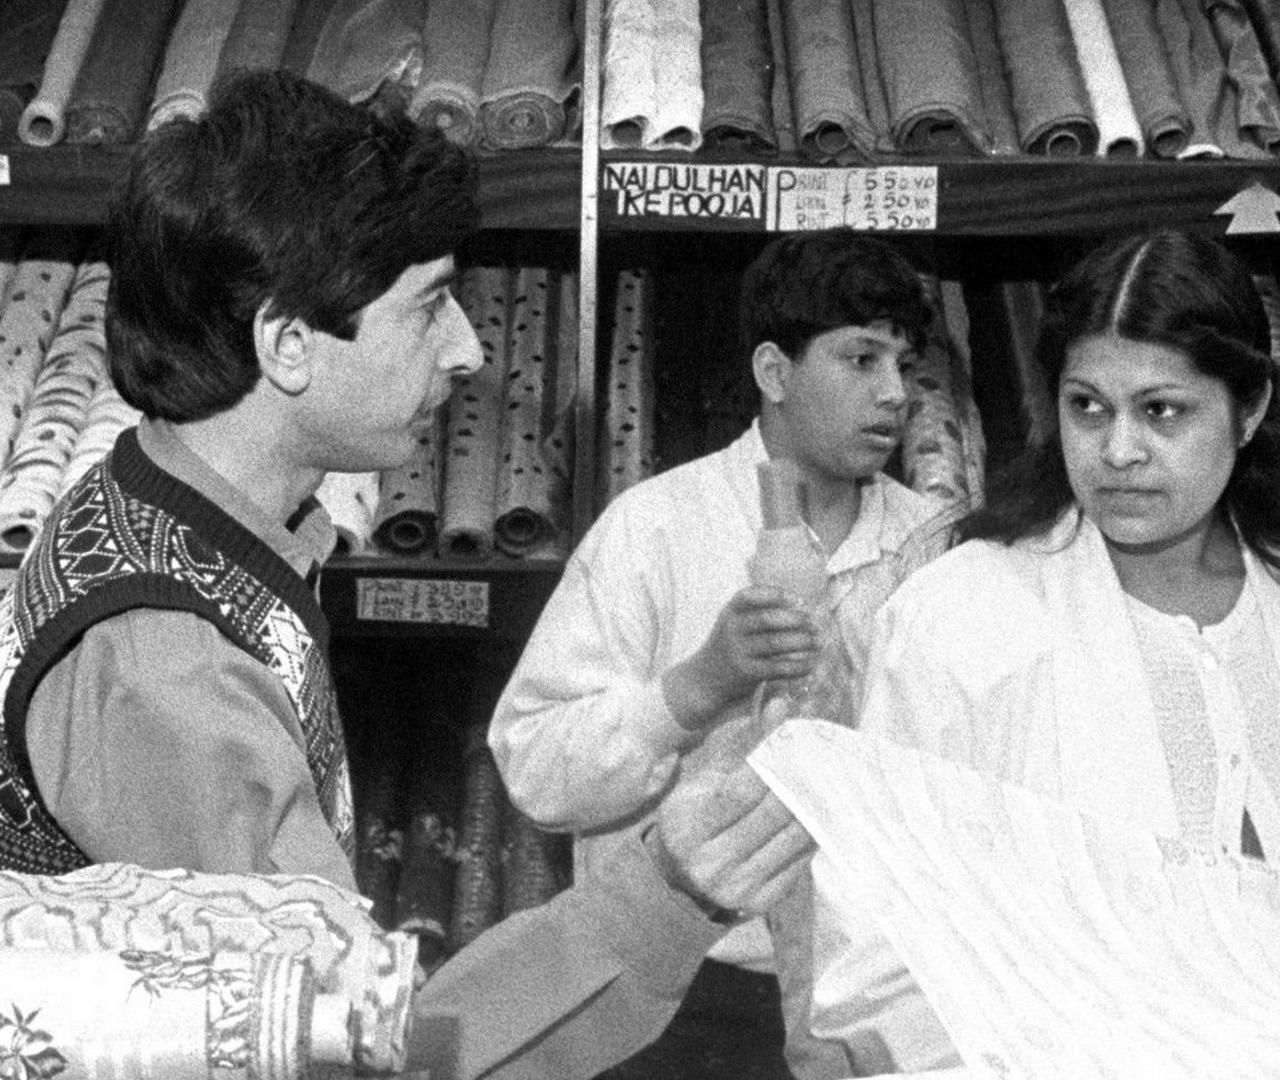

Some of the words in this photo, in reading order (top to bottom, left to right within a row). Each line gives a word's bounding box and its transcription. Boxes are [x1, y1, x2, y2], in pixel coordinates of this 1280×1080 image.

[654, 165, 766, 192] DULHAN
[622, 189, 661, 216] KE
[668, 191, 756, 218] POOJA
